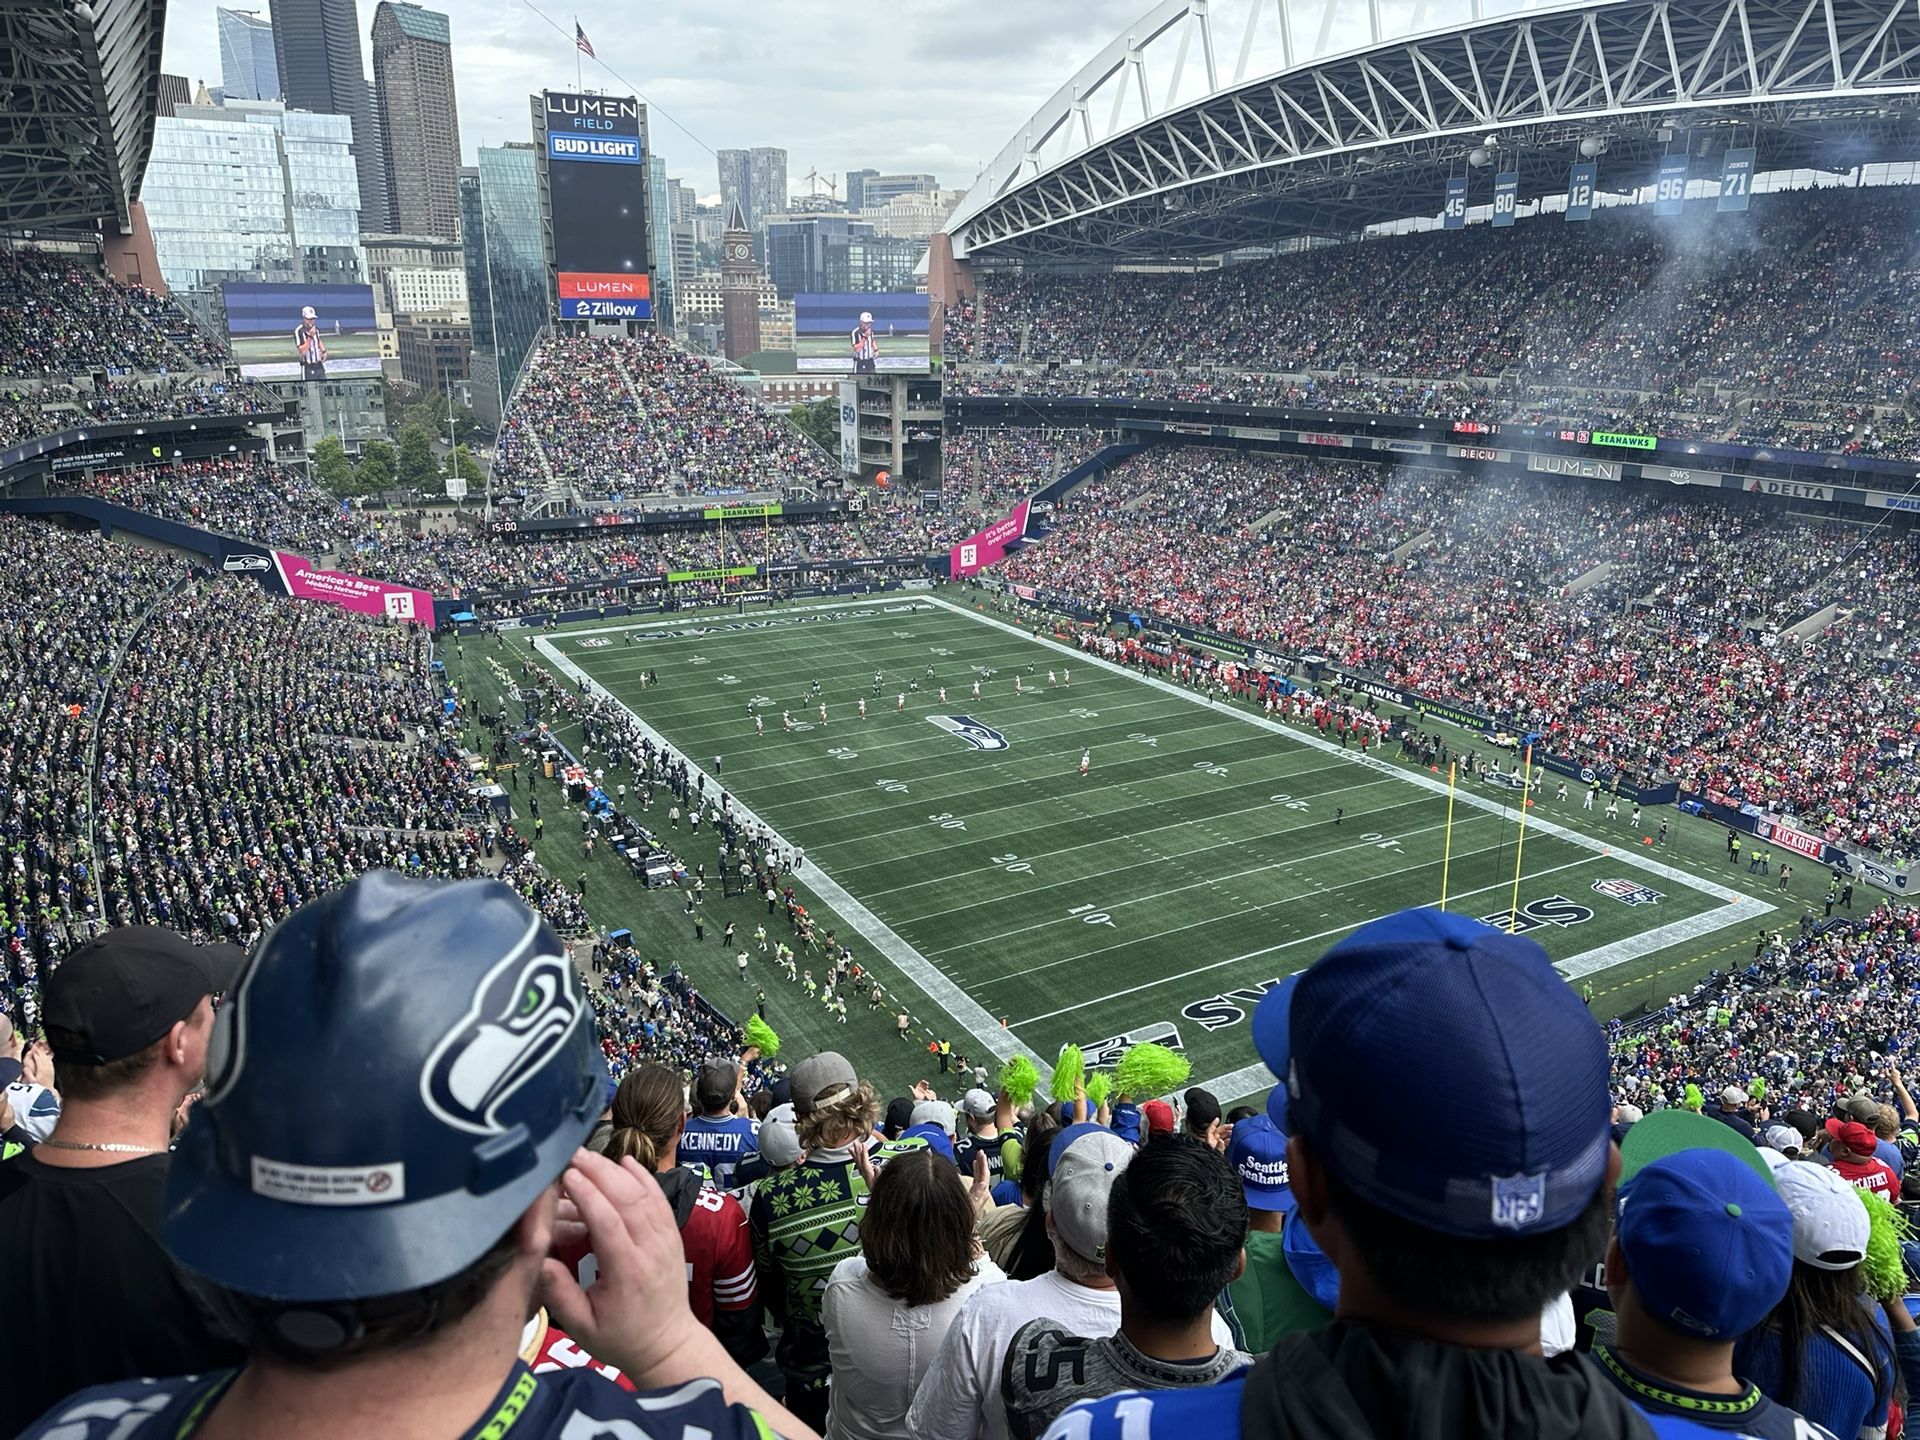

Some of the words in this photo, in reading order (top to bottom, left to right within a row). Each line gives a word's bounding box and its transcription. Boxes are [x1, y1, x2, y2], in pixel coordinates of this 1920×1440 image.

[546, 96, 638, 119] LUMEN
[574, 118, 614, 130] FIELD
[555, 139, 590, 154] BUD
[590, 141, 636, 157] LIGHT
[1658, 178, 1684, 201] 96
[1724, 173, 1748, 196] 71
[1495, 193, 1515, 214] 80
[1570, 185, 1590, 206] 12
[1446, 198, 1465, 217] 45
[577, 281, 633, 293] LUMEN
[592, 301, 638, 317] Zillow
[843, 405, 856, 423] 50
[1599, 434, 1650, 447] SEAHAWKS
[1534, 456, 1615, 479] LUMEN
[1669, 469, 1690, 479] aws
[1768, 482, 1825, 500] DELTA
[723, 508, 766, 517] SEAHAWKS
[491, 522, 517, 532] 15:00
[985, 529, 997, 539] It's
[996, 519, 1017, 534] better
[987, 535, 1002, 546] over
[1002, 526, 1018, 538] here
[295, 568, 354, 588] America's
[354, 581, 381, 593] Best
[693, 570, 732, 578] SEAHAWKS
[305, 579, 333, 590] Mobile
[333, 585, 368, 597] Network
[392, 597, 407, 614] T
[875, 779, 908, 792] 40
[929, 812, 965, 829] 30
[1360, 833, 1402, 849] 10
[1774, 828, 1818, 854] KICKOFF
[990, 853, 1031, 872] 20
[1067, 903, 1111, 924] 10
[680, 1132, 742, 1151] KENNEDY
[1246, 1155, 1288, 1172] Seattle
[1238, 1164, 1290, 1185] Seahawk
